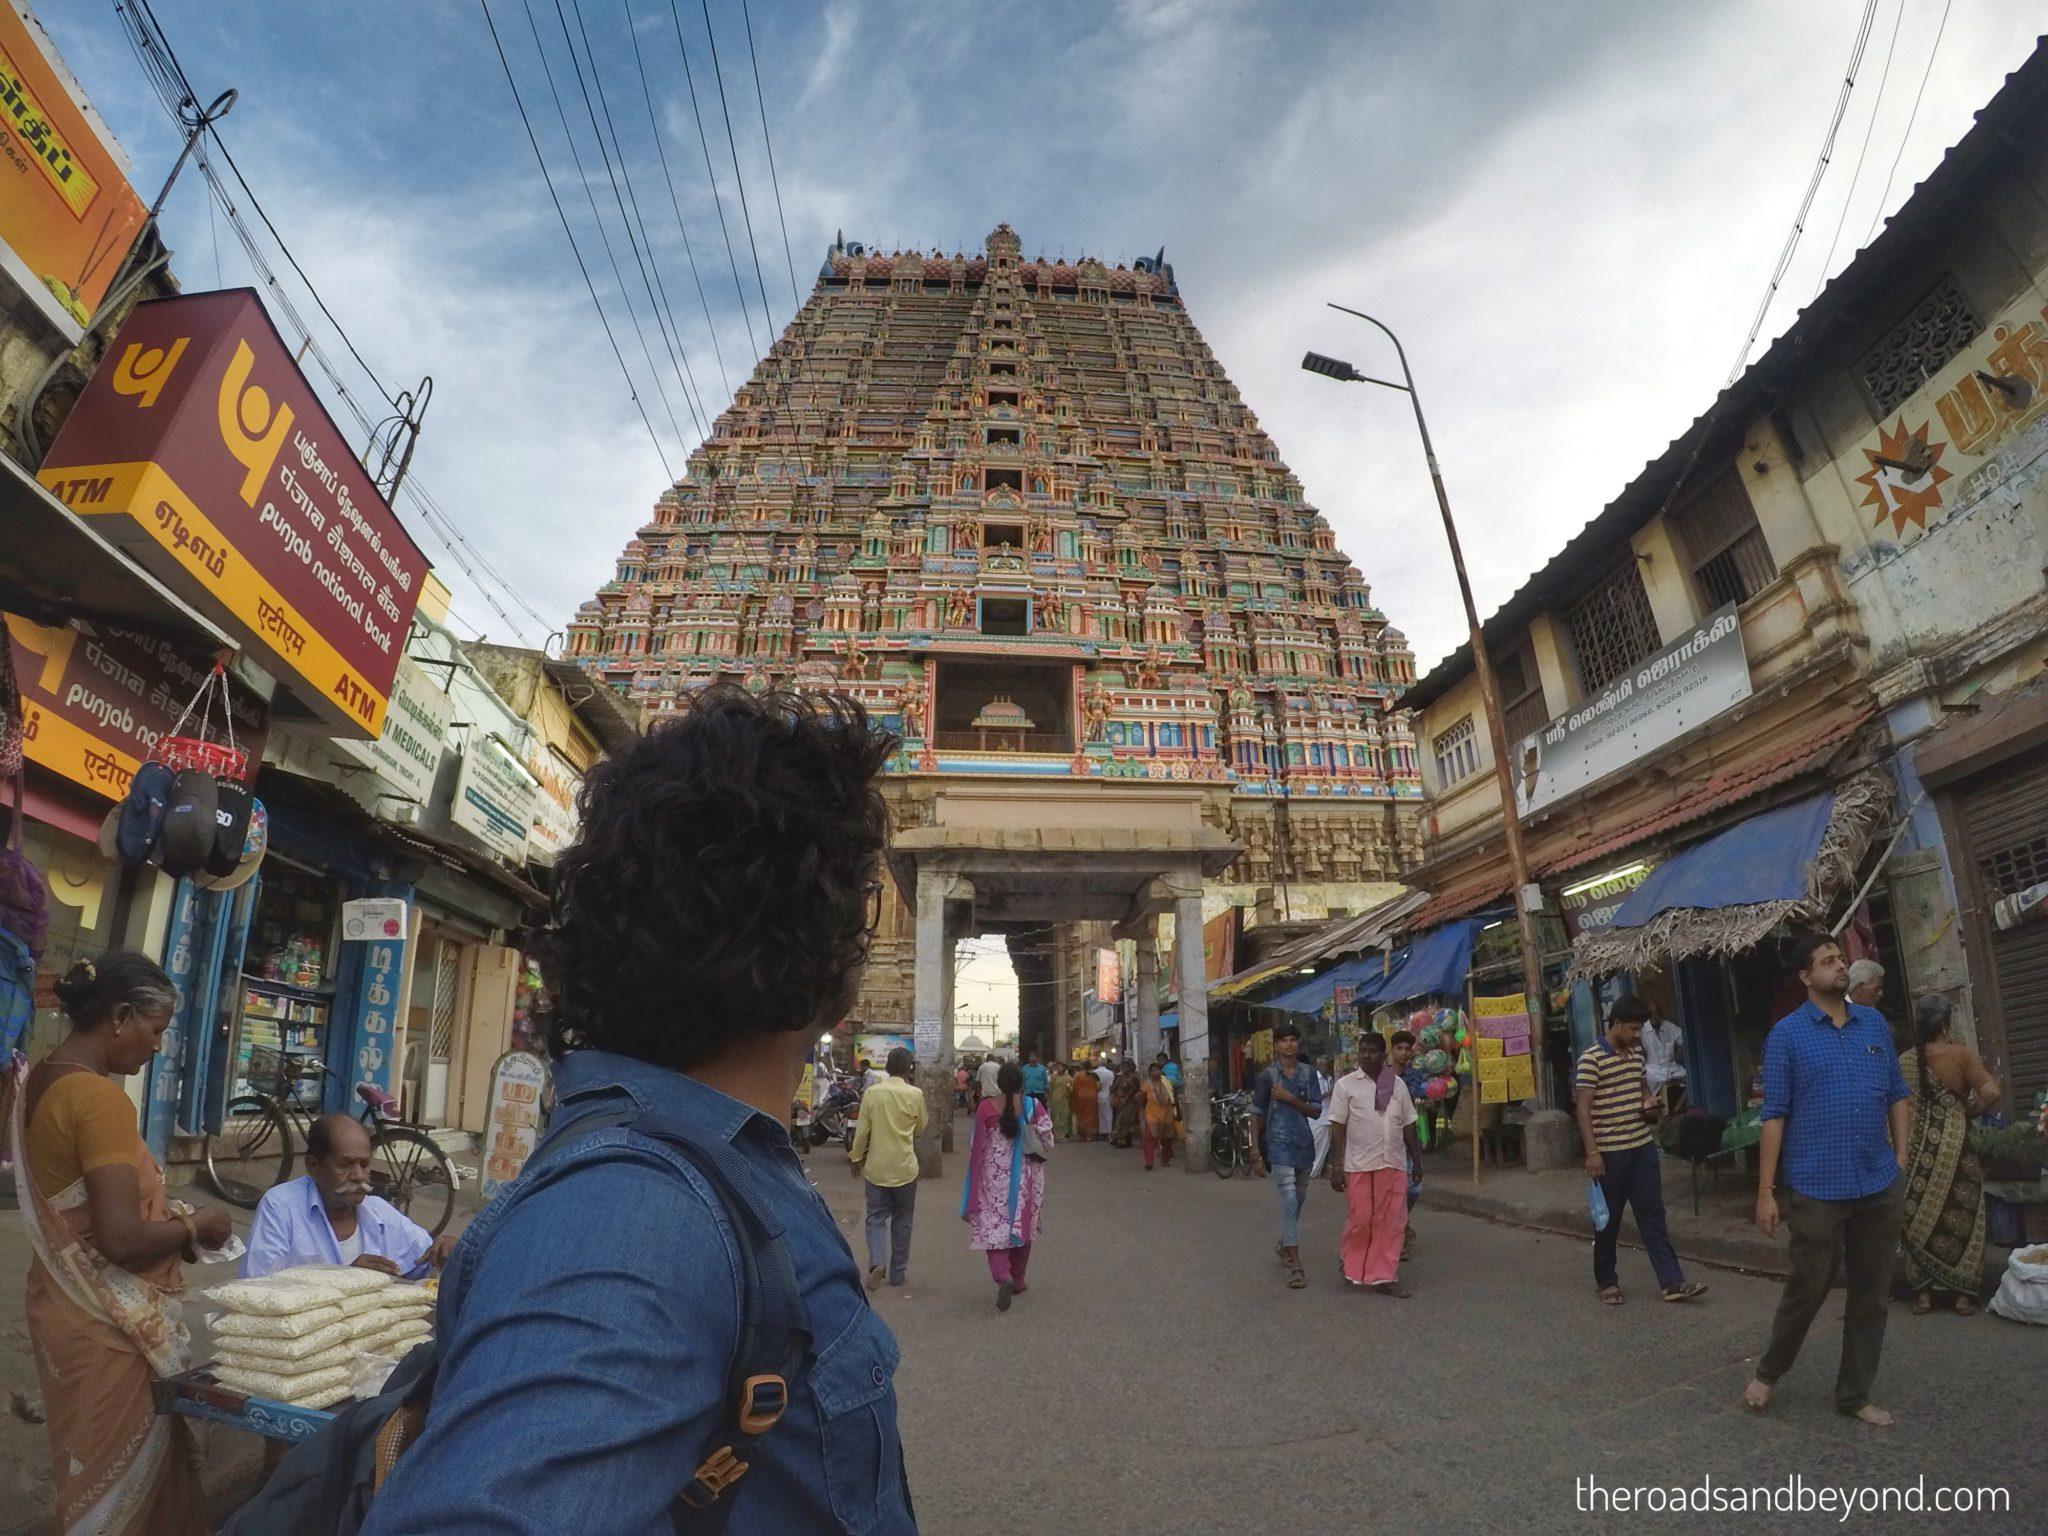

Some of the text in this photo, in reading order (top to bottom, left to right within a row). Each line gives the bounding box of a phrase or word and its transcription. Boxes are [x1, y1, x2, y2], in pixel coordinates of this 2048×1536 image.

[51, 477, 114, 504] ATM
[294, 430, 412, 592] பஞ்சாப் நேஷனல் வங்கி
[155, 500, 228, 578] ஏடிஎம்
[280, 465, 400, 623] पंजाब नैशनल बैंक
[260, 502, 391, 654] punjab national bank
[258, 596, 306, 656] एटीएम
[1636, 613, 1737, 690] ஜெராக்ஸ்
[65, 682, 134, 733] punjab
[334, 673, 377, 723] ATM
[84, 748, 132, 796] एटीए
[392, 724, 437, 772] MEDICALS
